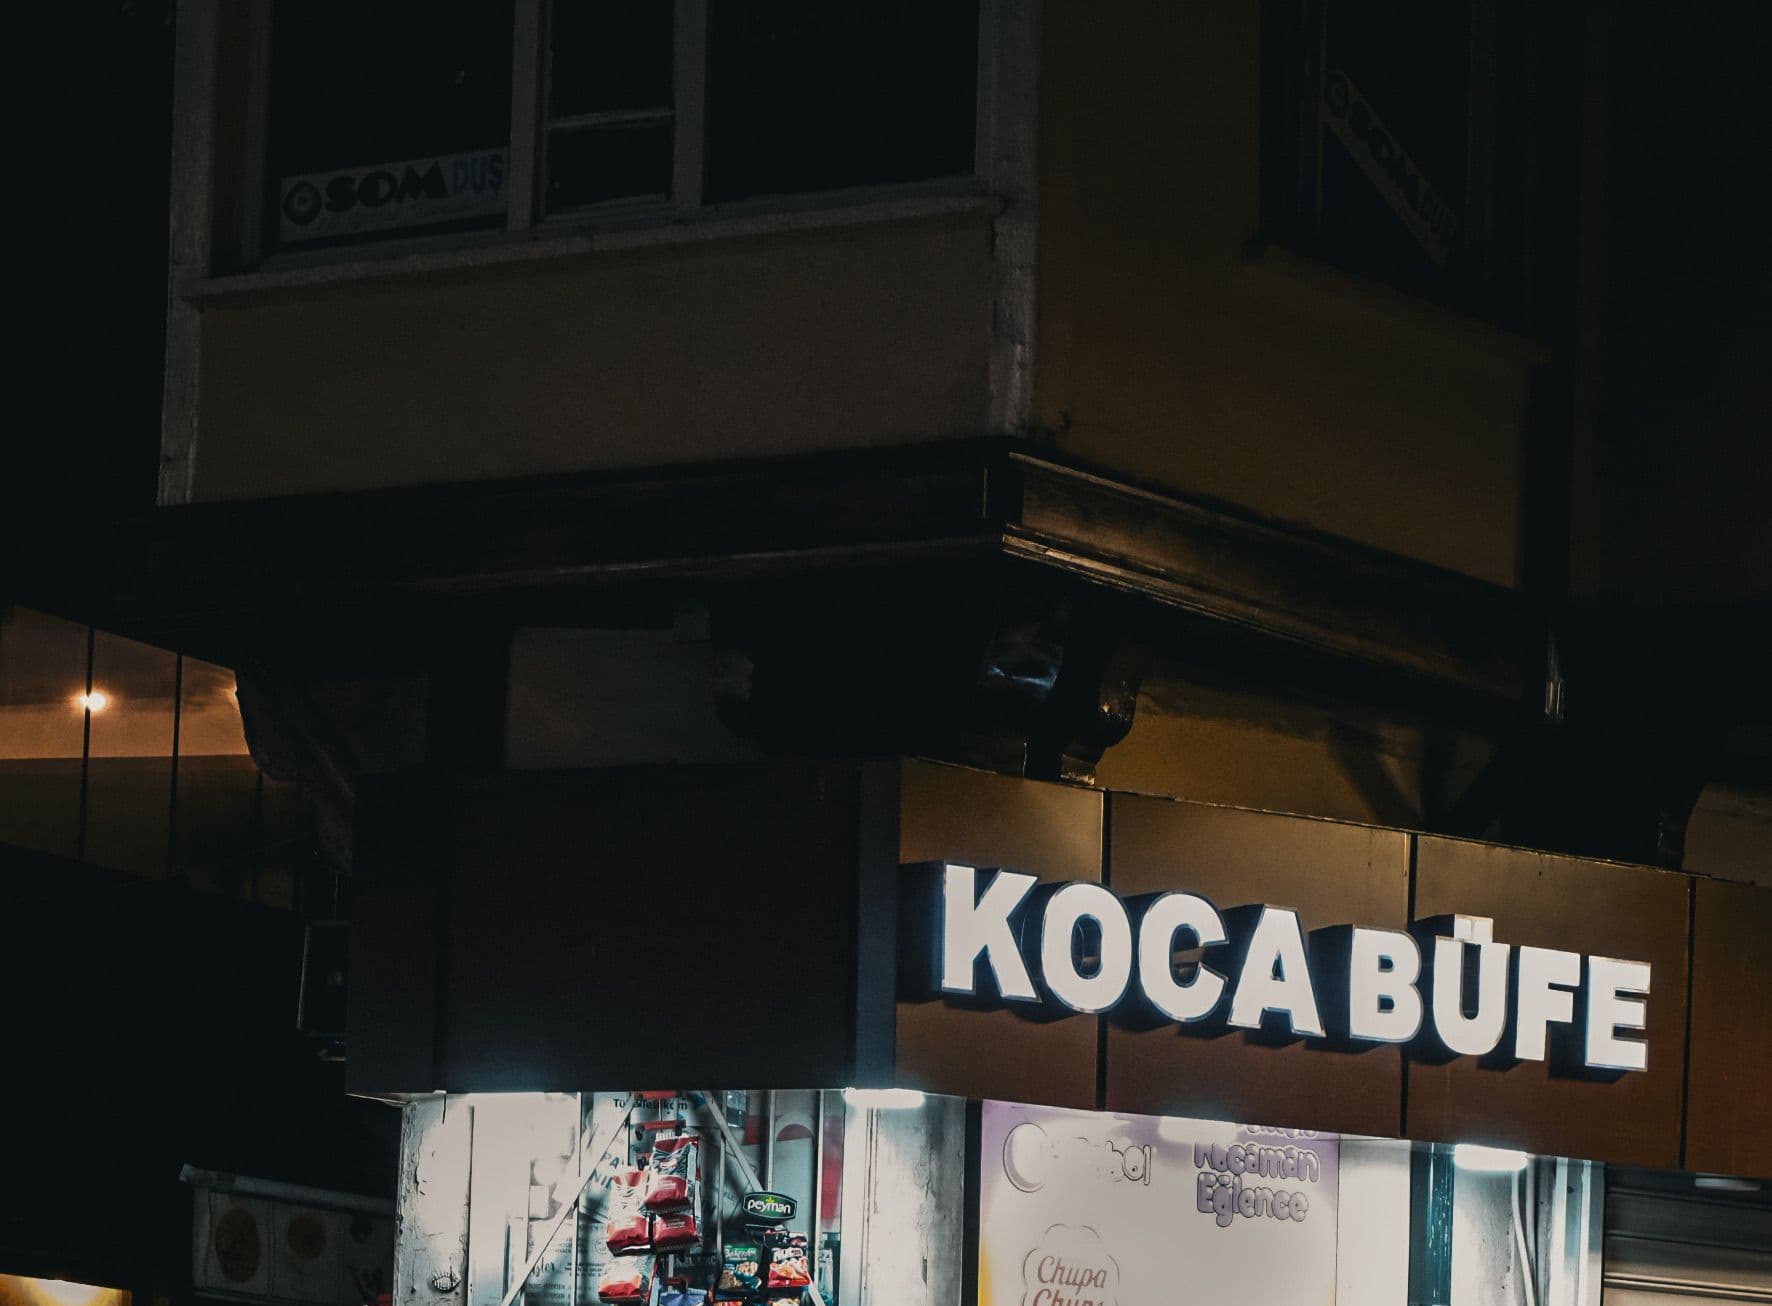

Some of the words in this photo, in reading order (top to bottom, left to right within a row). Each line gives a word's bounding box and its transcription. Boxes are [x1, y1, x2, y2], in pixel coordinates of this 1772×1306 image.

[941, 863, 1326, 1038] KOCA
[1350, 914, 1651, 1072] BÜFE
[747, 1198, 791, 1214] peyman
[1037, 1255, 1107, 1295] Chupa
